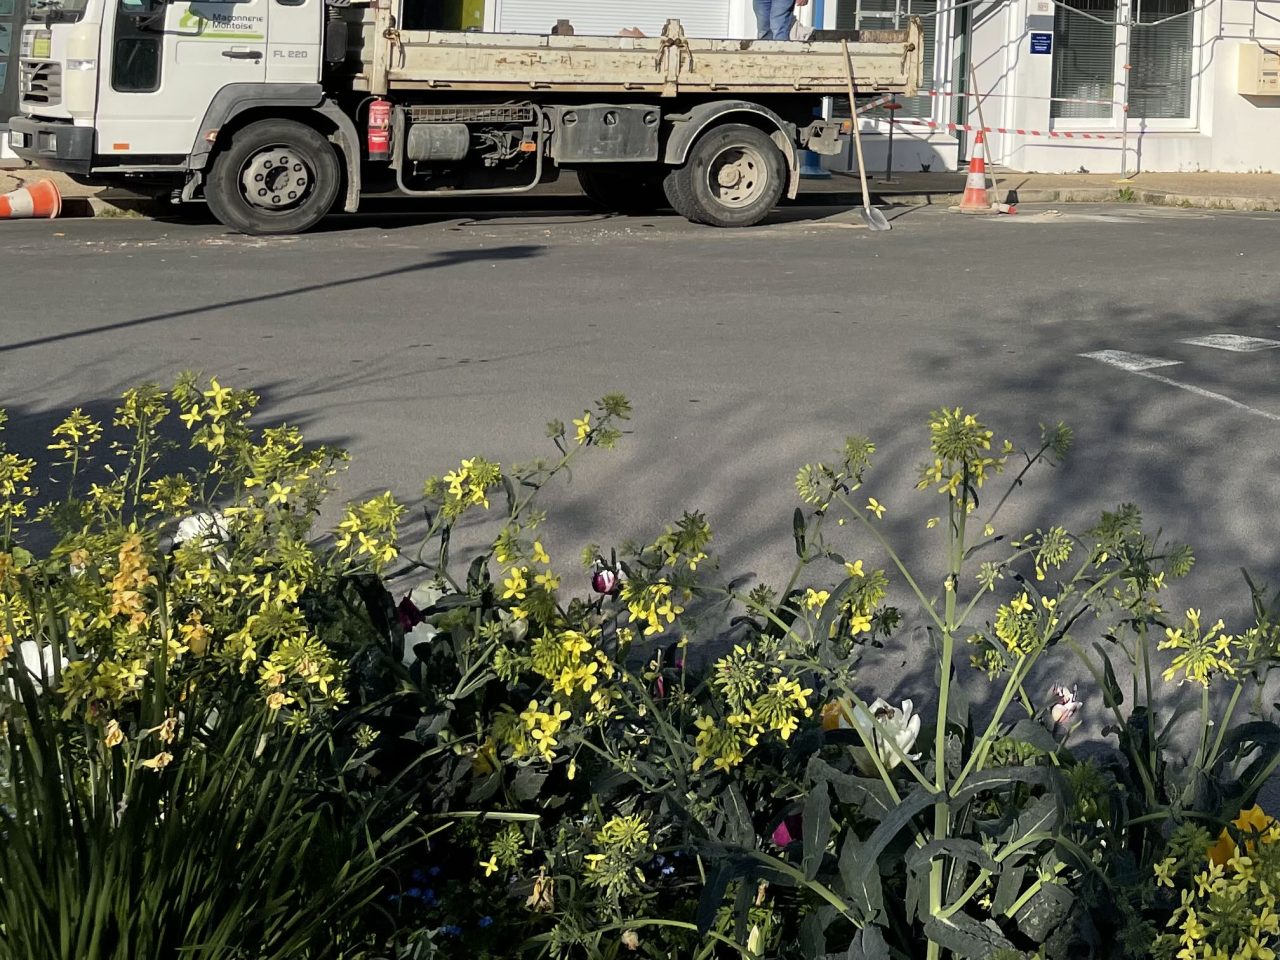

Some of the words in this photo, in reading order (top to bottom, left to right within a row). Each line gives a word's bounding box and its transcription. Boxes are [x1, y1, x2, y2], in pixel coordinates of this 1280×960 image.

[212, 13, 264, 24] Maçonnerie
[212, 21, 254, 30] Montoise
[273, 50, 286, 58] FL
[288, 51, 308, 59] 220
